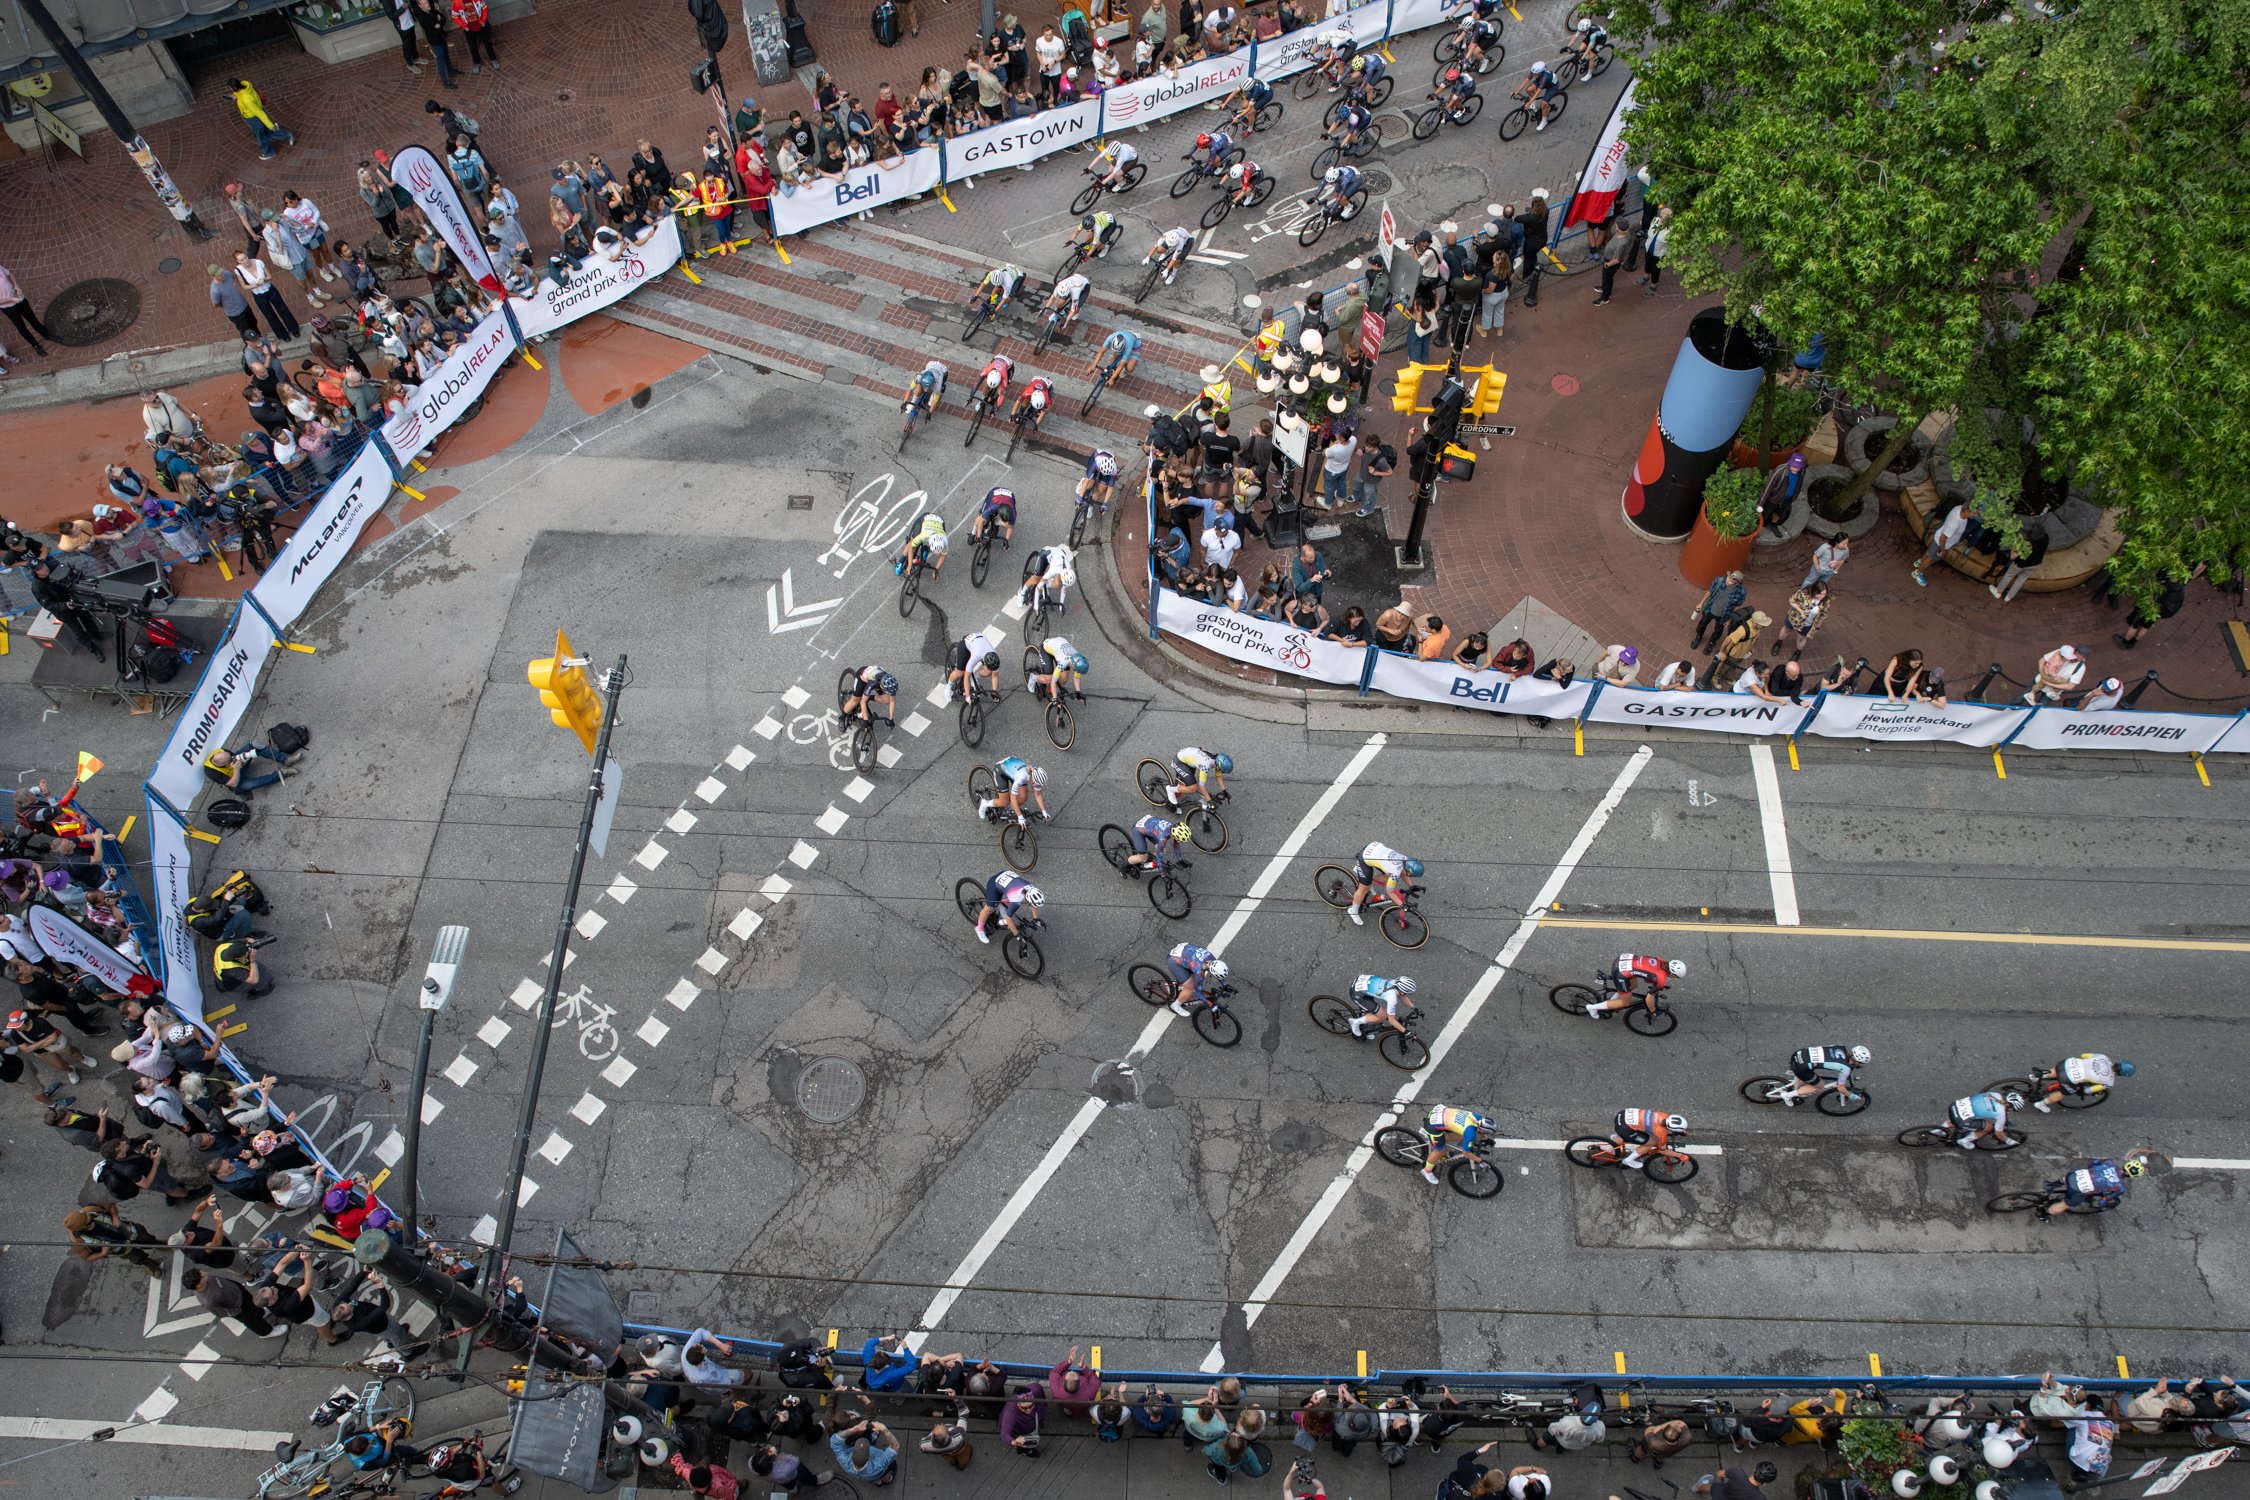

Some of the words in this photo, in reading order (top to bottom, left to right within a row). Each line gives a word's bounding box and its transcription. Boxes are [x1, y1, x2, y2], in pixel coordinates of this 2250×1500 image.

[1281, 36, 1318, 57] gastow
[964, 115, 1084, 162] GASTOWN
[835, 173, 881, 207] Bell
[547, 268, 602, 304] gastown
[552, 285, 591, 316] grand
[594, 275, 618, 297] prix
[1462, 425, 1498, 433] CORDOVA
[291, 493, 359, 586] McLaren
[334, 502, 364, 543] VANCOUVER
[1196, 611, 1264, 639] gastown
[1196, 621, 1243, 644] grand
[1244, 637, 1274, 656] prix
[182, 648, 249, 766] PROMOSAPIEN
[1450, 676, 1511, 704] Bell
[1623, 702, 1779, 722] GASTOWN
[1856, 722, 1922, 734] Enterprise
[1861, 713, 1916, 725] Hewlett
[1916, 715, 1973, 730] Packard
[2060, 723, 2188, 740] PROMOSAPIEN
[169, 853, 180, 909] Packard
[175, 910, 184, 965] Hewlett
[182, 926, 192, 972] Enterp
